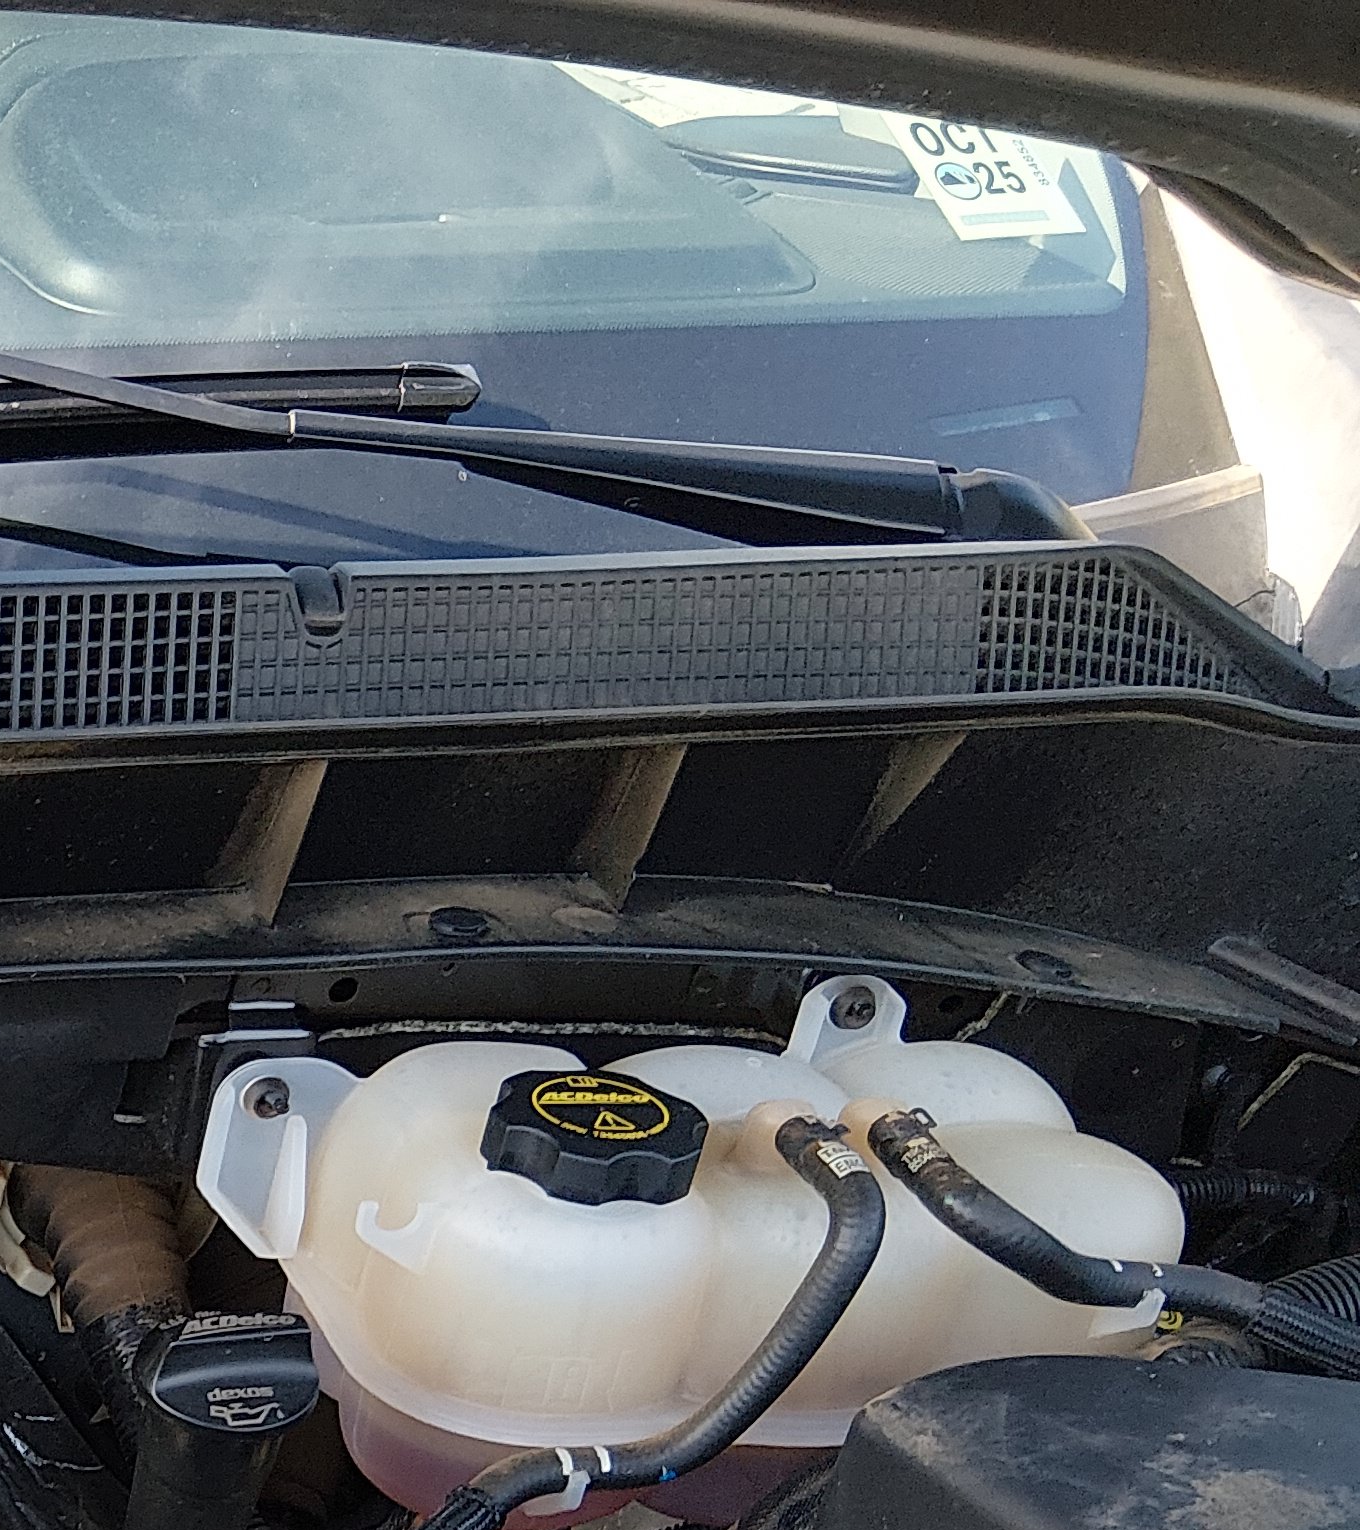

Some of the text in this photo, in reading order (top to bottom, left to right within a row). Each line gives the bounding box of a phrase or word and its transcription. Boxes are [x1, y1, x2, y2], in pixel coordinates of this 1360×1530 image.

[972, 160, 1026, 194] 25
[539, 1091, 651, 1104] ACDelco
[182, 1313, 296, 1335] ACDelco
[207, 1386, 274, 1401] dexos
